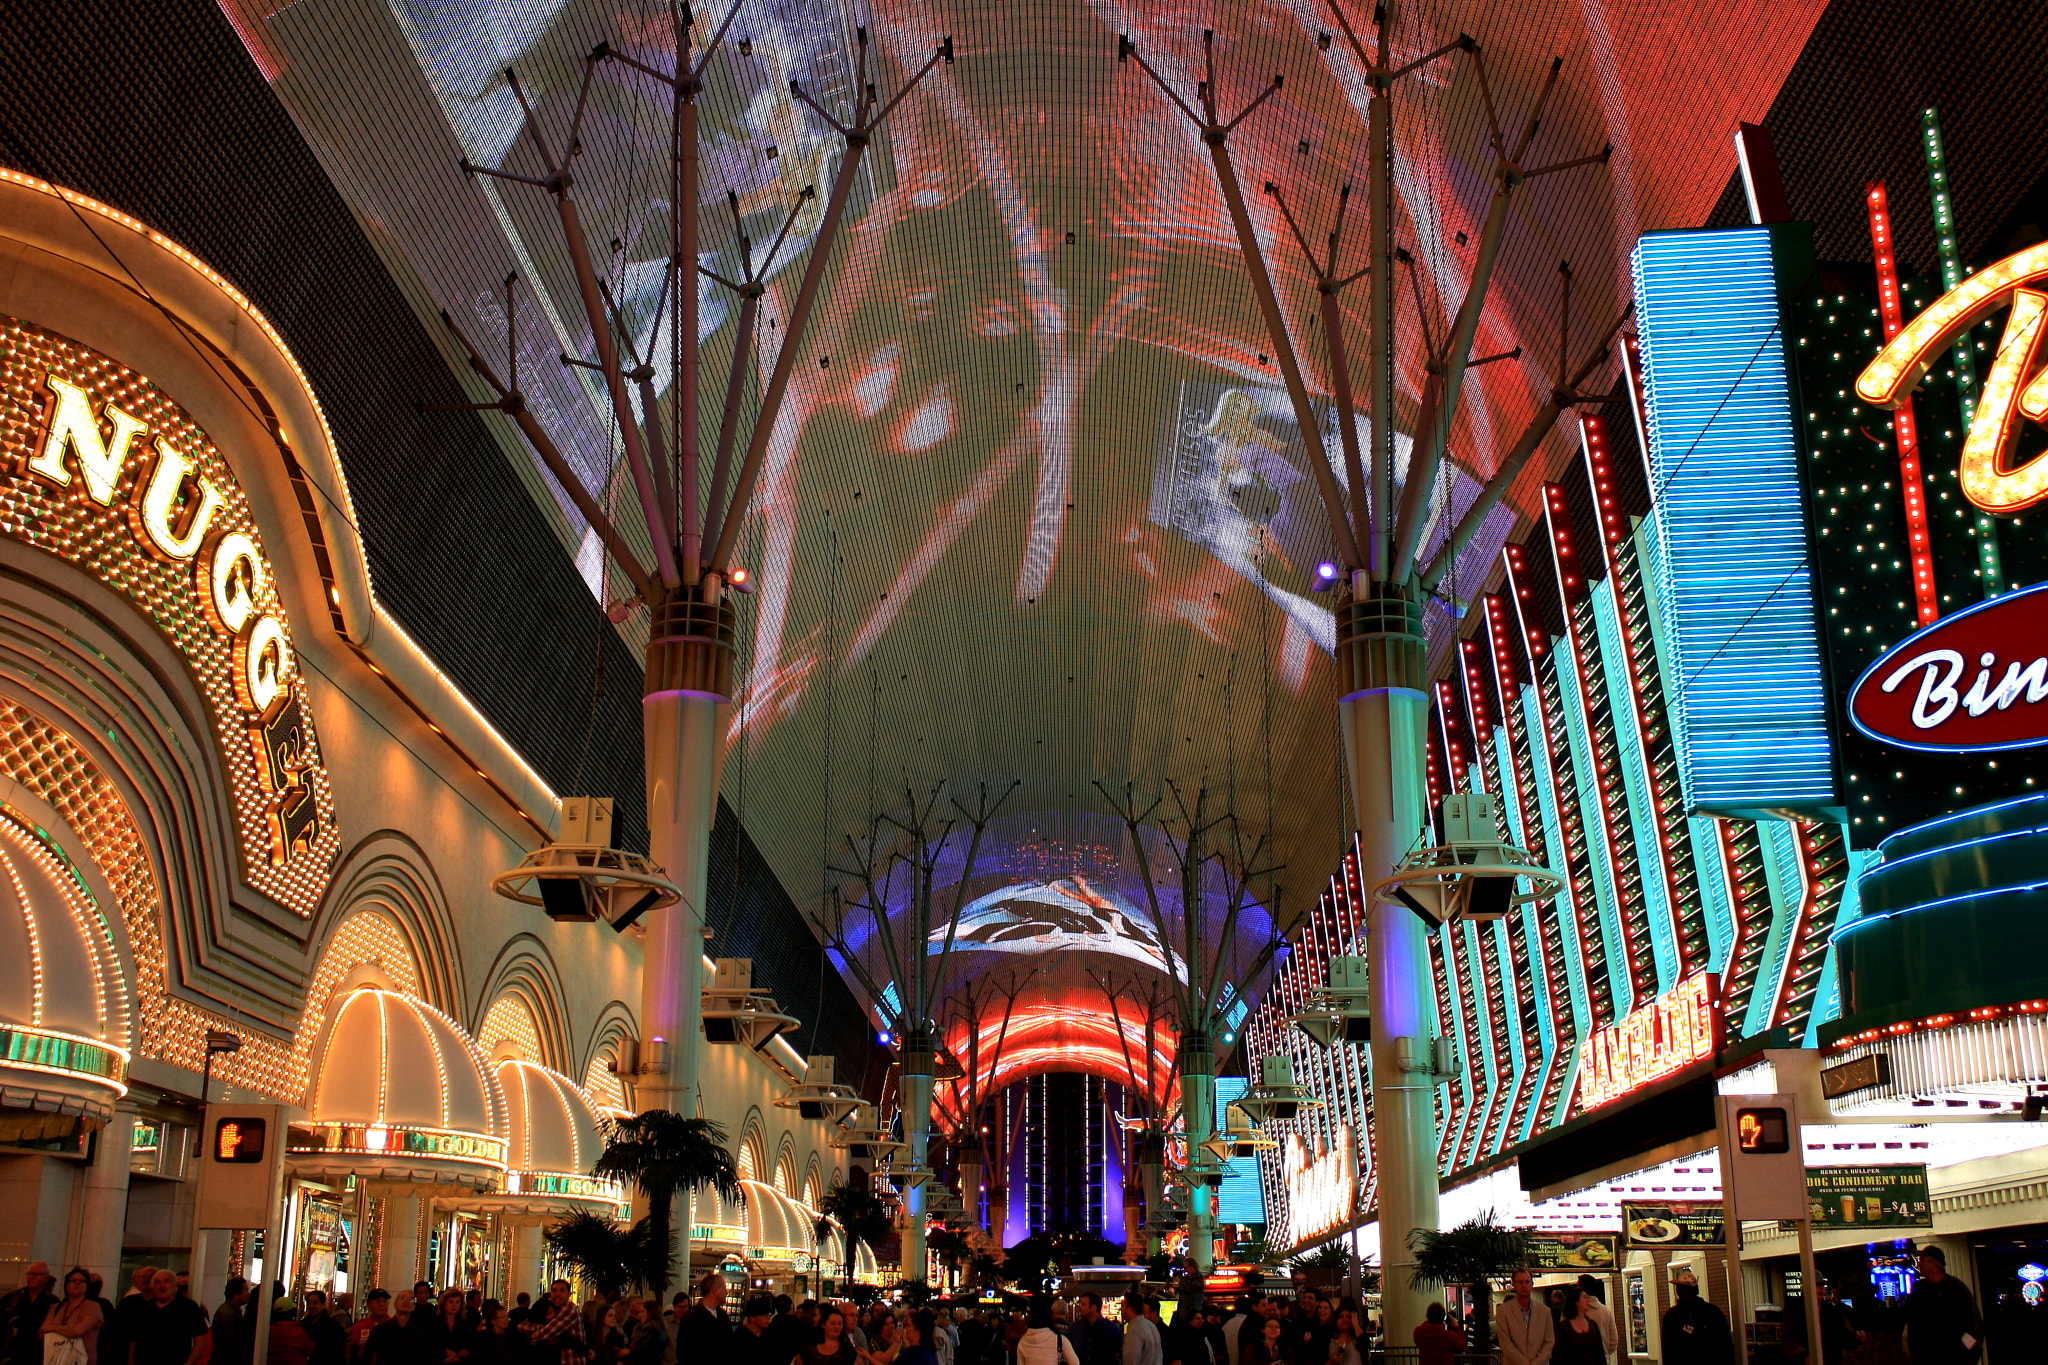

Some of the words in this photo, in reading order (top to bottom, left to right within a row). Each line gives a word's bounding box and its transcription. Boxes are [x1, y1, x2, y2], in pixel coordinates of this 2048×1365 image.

[27, 373, 322, 866] NUGGET
[1579, 969, 1713, 1112] GAMBLING
[1806, 1177, 1829, 1187] DOG
[1832, 1175, 1896, 1186] CONDIMENT
[1900, 1174, 1923, 1185] BAR
